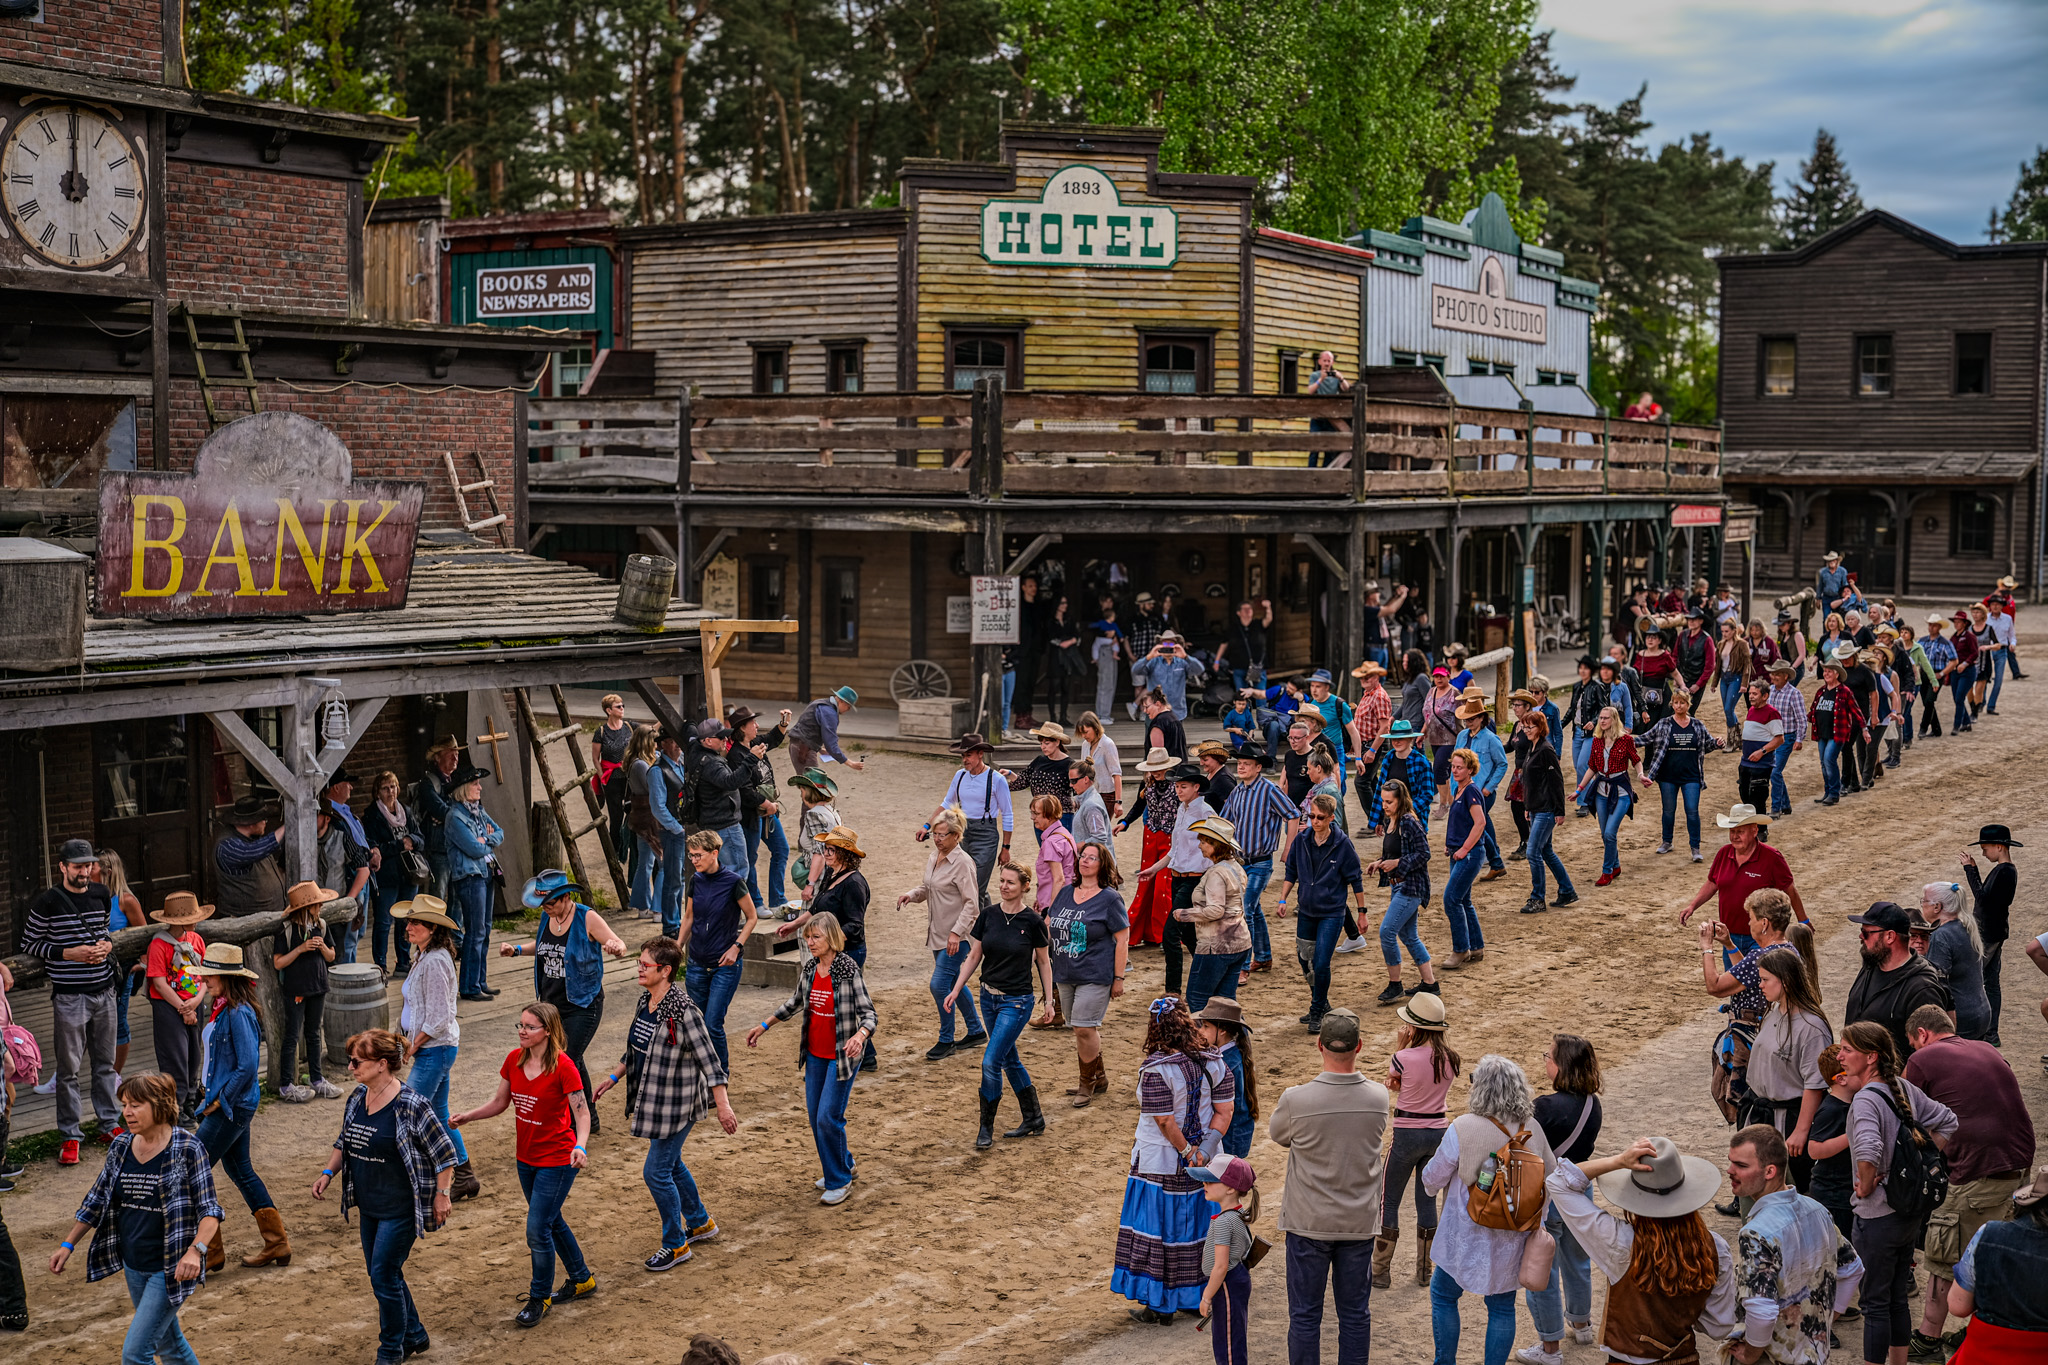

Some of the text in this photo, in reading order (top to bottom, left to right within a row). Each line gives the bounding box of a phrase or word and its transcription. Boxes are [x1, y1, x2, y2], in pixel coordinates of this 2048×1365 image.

[18, 140, 40, 161] X
[114, 186, 135, 201] III
[1062, 181, 1100, 195] 1893
[998, 211, 1164, 258] HOTEL
[482, 273, 591, 292] BOOKS AND
[482, 291, 591, 311] NEWSPAPERS
[1436, 295, 1543, 335] PHOTO STUDIO
[121, 495, 400, 597] BANK
[981, 613, 1011, 623] CLEAN
[1050, 916, 1070, 930] ETTER
[1058, 907, 1085, 920] LIFE IS
[1060, 930, 1070, 941] IN
[1052, 938, 1079, 959] Boots
